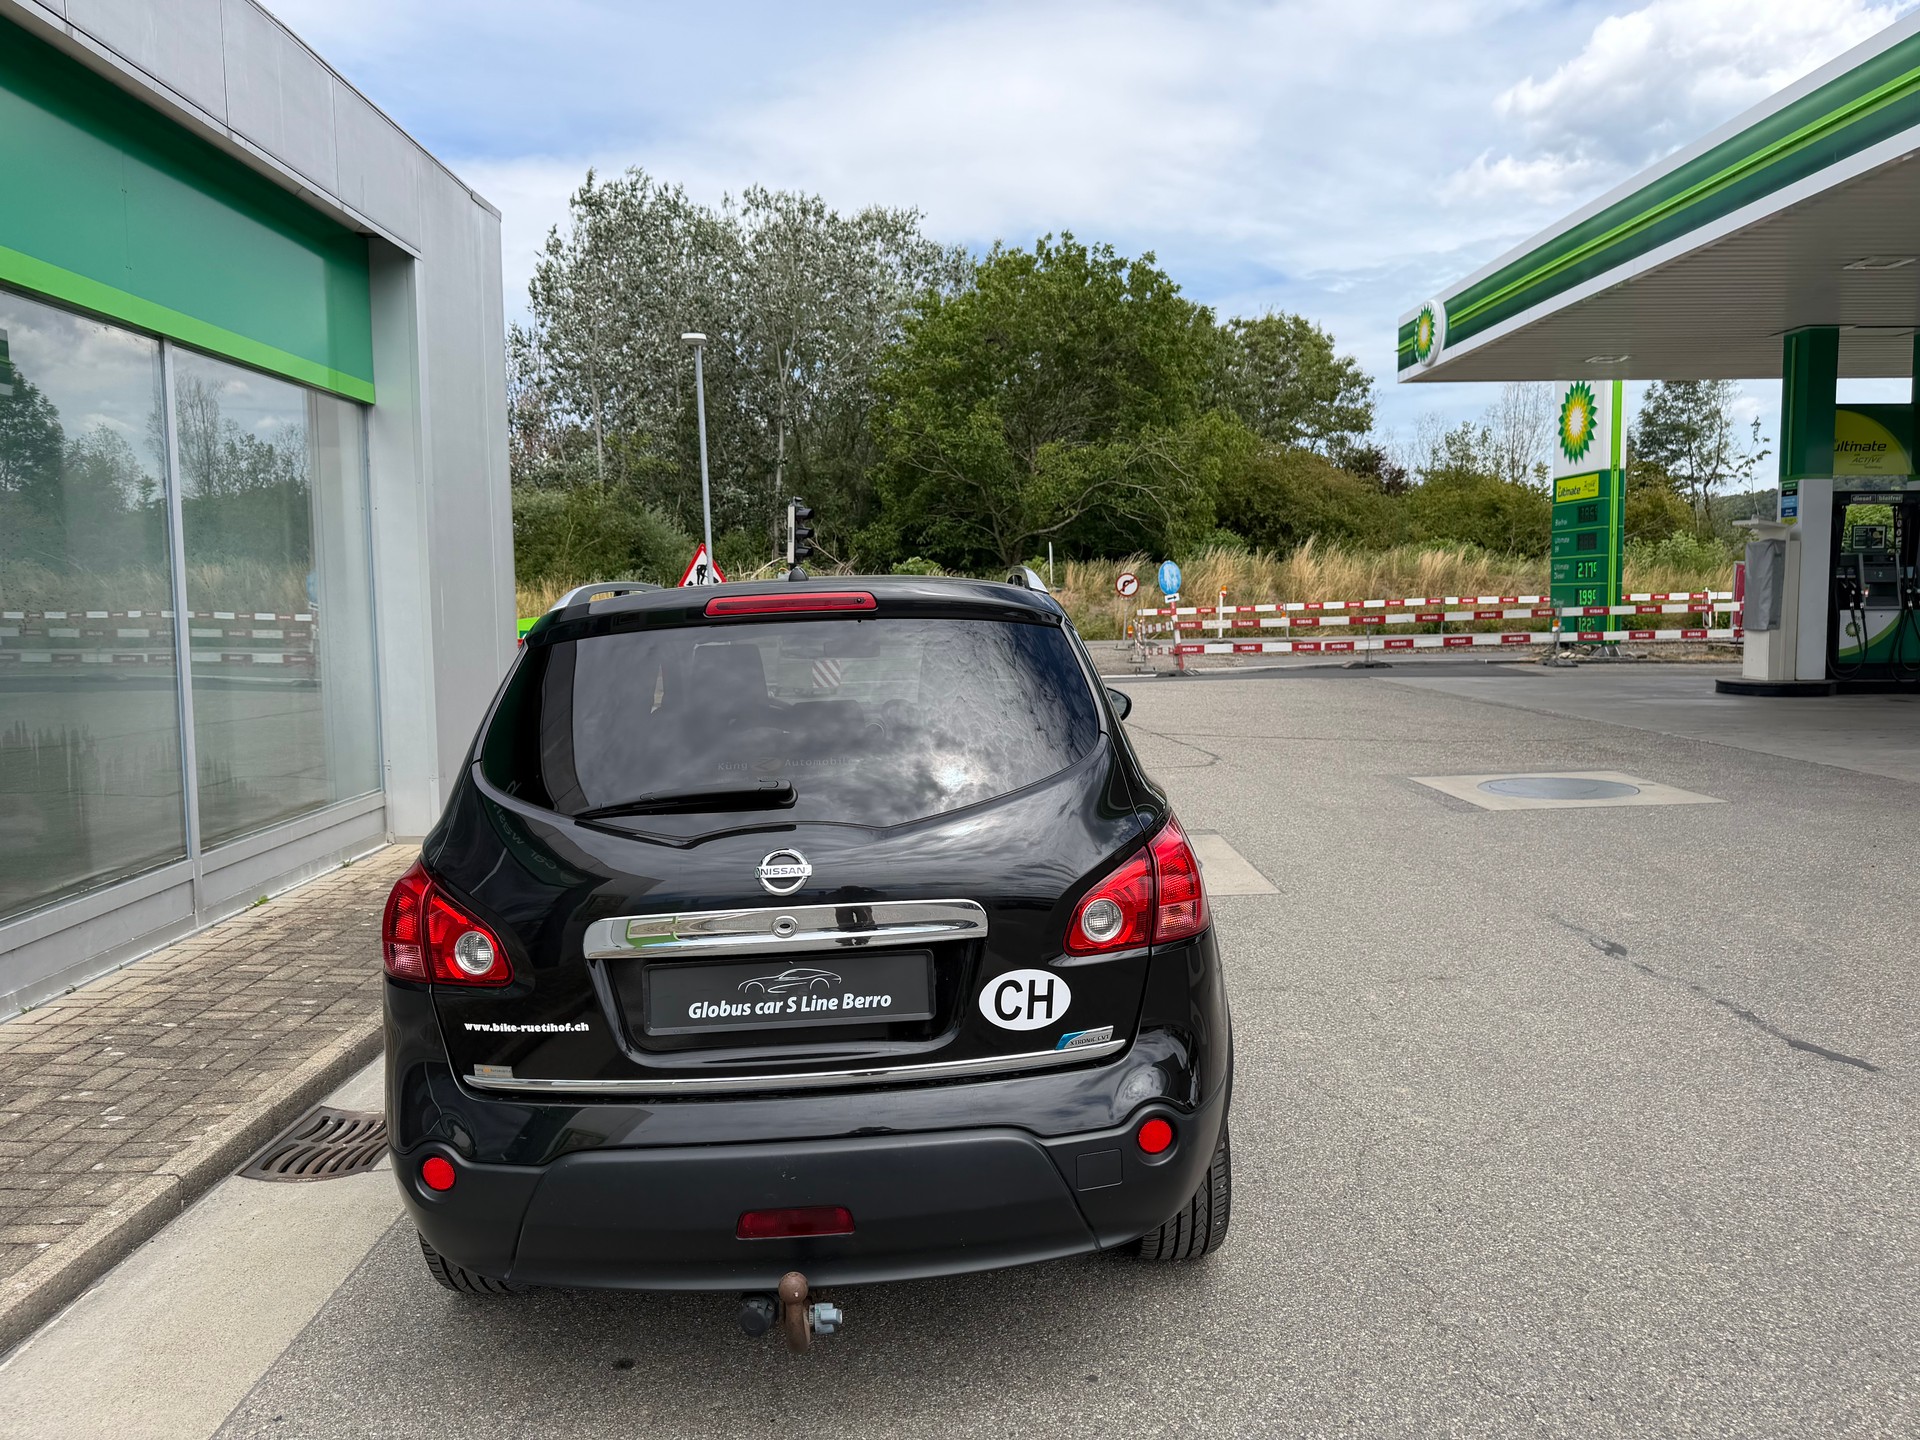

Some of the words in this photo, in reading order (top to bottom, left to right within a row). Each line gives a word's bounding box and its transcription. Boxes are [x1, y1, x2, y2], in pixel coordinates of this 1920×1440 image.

[760, 867, 806, 876] NISSAN
[688, 1001, 751, 1019] Globus
[755, 1001, 783, 1014] car
[787, 997, 797, 1013] S
[801, 996, 838, 1012] Line
[842, 993, 892, 1009] Berro
[994, 979, 1055, 1021] CH
[464, 1022, 590, 1032] www.bike-ruetihof.ch
